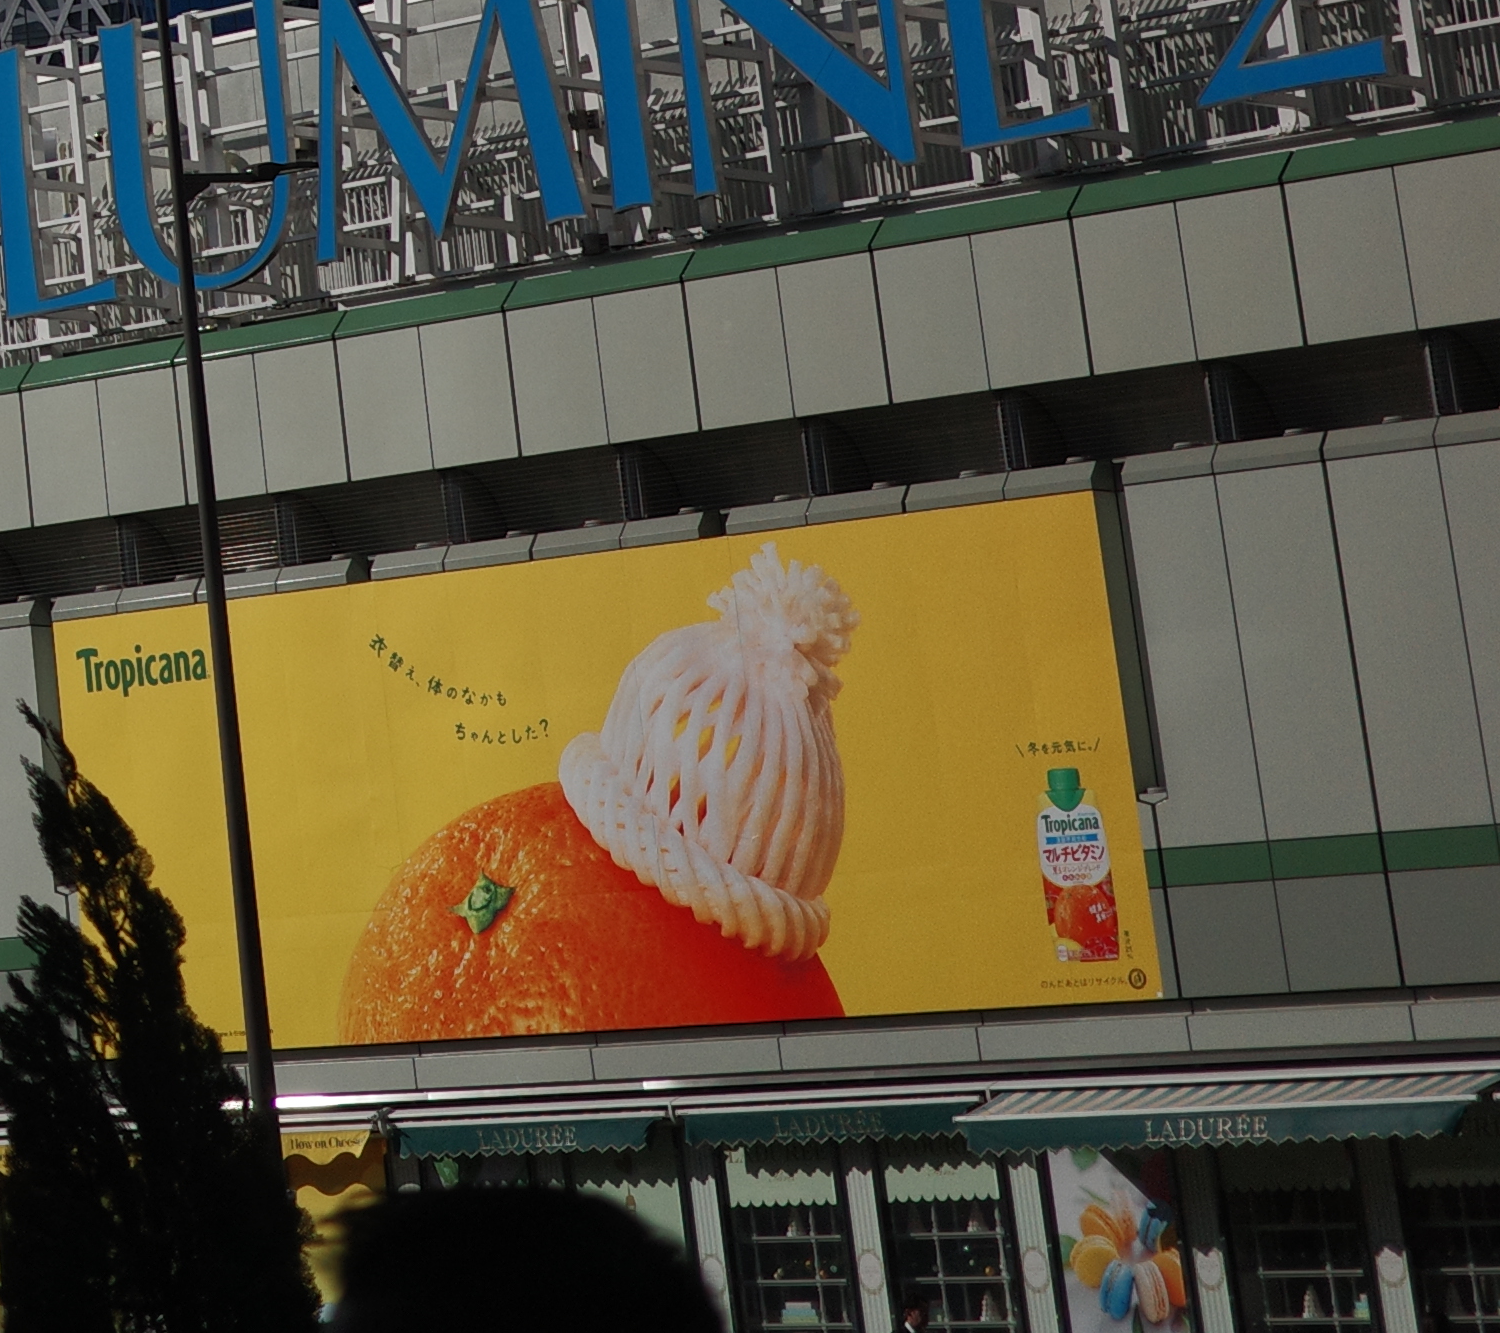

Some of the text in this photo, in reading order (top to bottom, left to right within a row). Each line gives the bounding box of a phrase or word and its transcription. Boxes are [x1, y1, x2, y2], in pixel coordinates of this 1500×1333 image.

[75, 644, 208, 698] Tropicana
[1041, 814, 1100, 835] Tropicana
[1042, 844, 1105, 863] マルチビタミン
[477, 1123, 577, 1150] LADURÉE
[1143, 1113, 1269, 1144] LADURÉE
